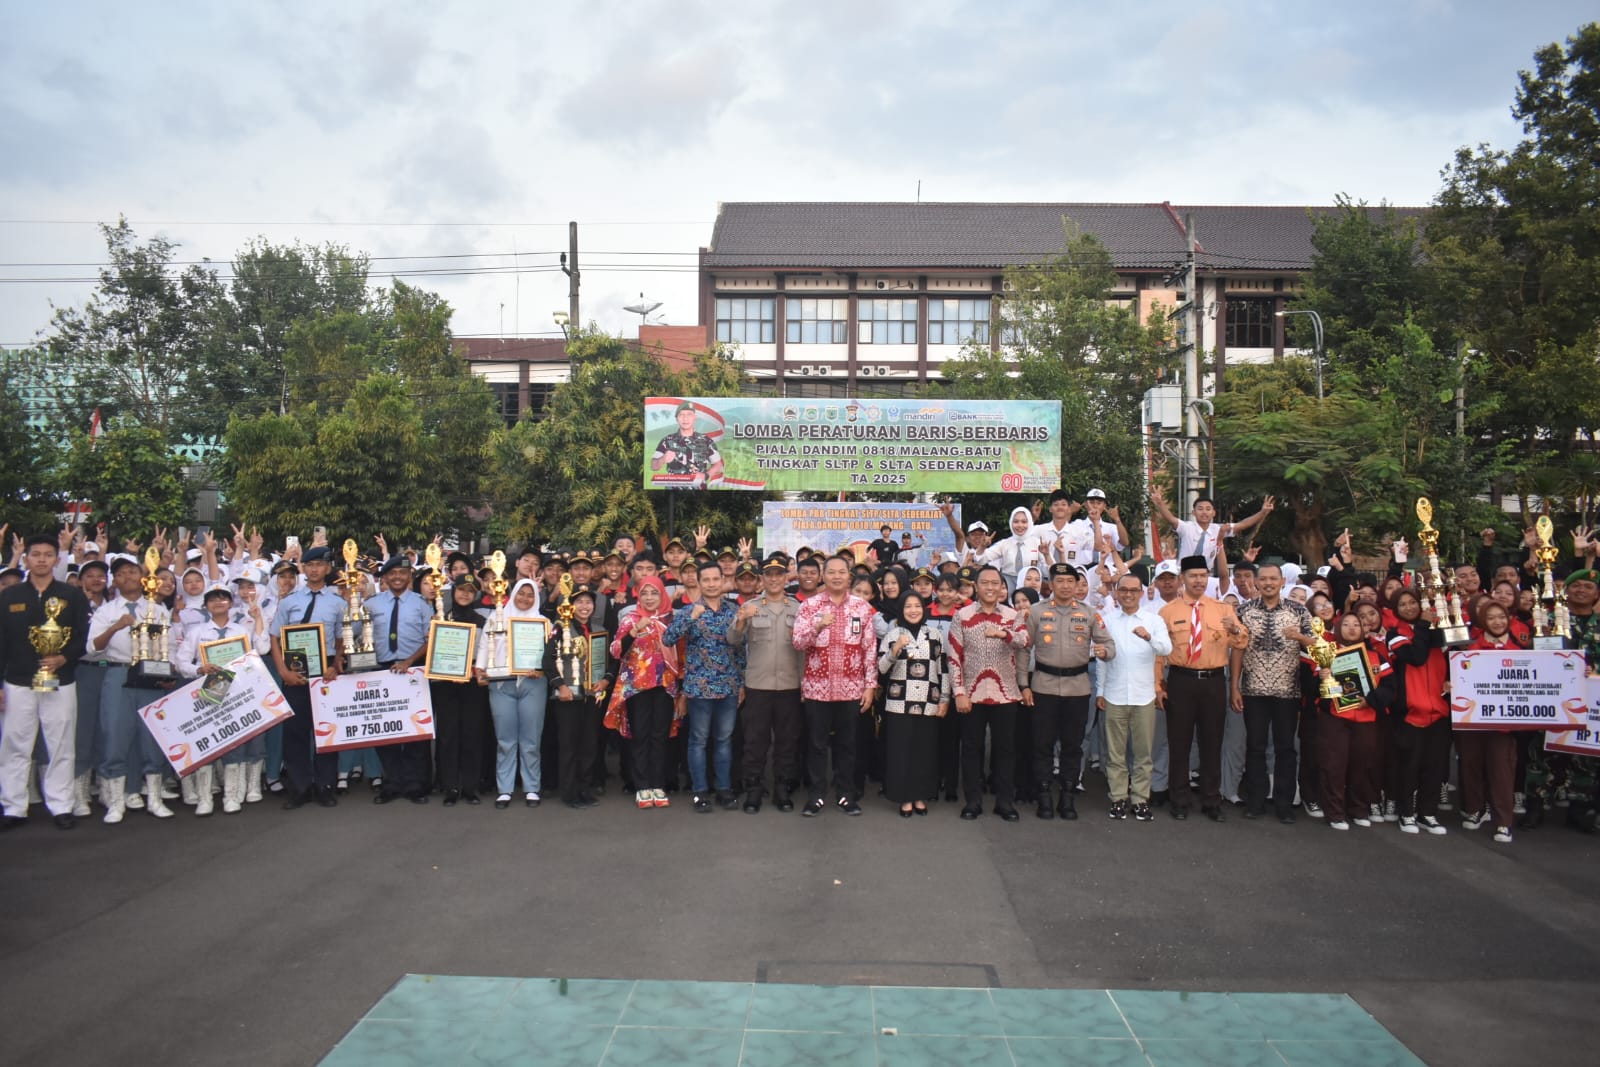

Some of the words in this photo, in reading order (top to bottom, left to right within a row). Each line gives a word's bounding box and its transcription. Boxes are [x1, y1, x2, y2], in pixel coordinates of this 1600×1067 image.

[734, 424, 793, 439] LOMBA
[798, 424, 900, 440] PERATURAN
[907, 426, 1049, 440] BARIS-BERBARIS
[756, 445, 797, 455] PIALA
[803, 445, 857, 455] DANDIM
[757, 458, 819, 469] TINGKAT
[825, 459, 859, 469] SLTP
[864, 459, 874, 470] &
[880, 460, 914, 470] SLTA
[919, 460, 1001, 471] SEDERAJAT
[851, 473, 868, 484] TA
[873, 474, 907, 484] 2025
[1001, 473, 1023, 491] 80
[780, 509, 807, 518] LOMBA
[827, 509, 859, 518] TINGKAT
[902, 510, 943, 519] SEDERAJAT
[793, 521, 815, 529] PIALA
[817, 521, 848, 530] DANDIM
[911, 521, 932, 530] BATU
[1497, 669, 1530, 680] JUARA
[1532, 669, 1537, 680] 1
[353, 689, 381, 702] JUARA
[383, 688, 389, 698] 3
[1482, 705, 1495, 717] RP
[1498, 705, 1556, 718] 1.500.000
[195, 736, 210, 752] RP
[211, 709, 262, 743] 1.000.000
[346, 726, 358, 738] RP
[362, 720, 403, 736] 750.000
[1577, 729, 1591, 741] RP
